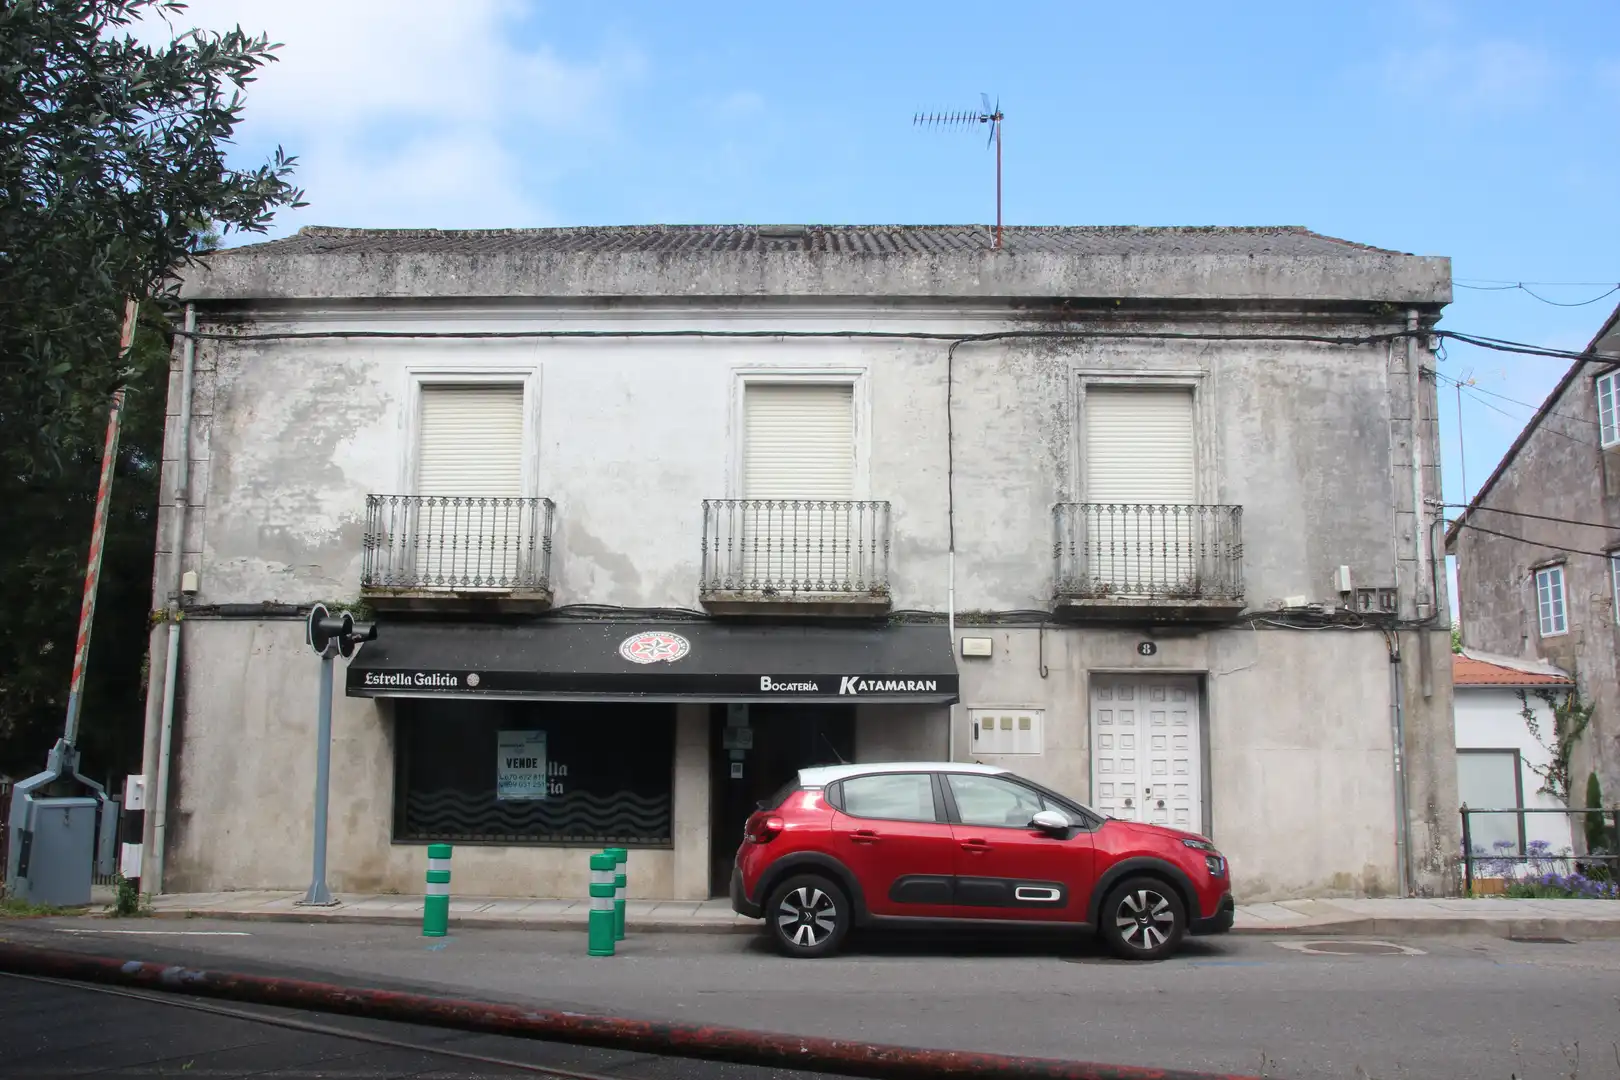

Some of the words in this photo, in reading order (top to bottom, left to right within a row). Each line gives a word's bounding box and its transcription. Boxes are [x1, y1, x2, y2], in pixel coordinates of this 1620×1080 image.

[1143, 643, 1151, 654] 8
[364, 672, 412, 685] Estrella
[414, 672, 458, 686] Galicia
[839, 676, 937, 695] KATAMARAN
[506, 757, 538, 769] VENDE
